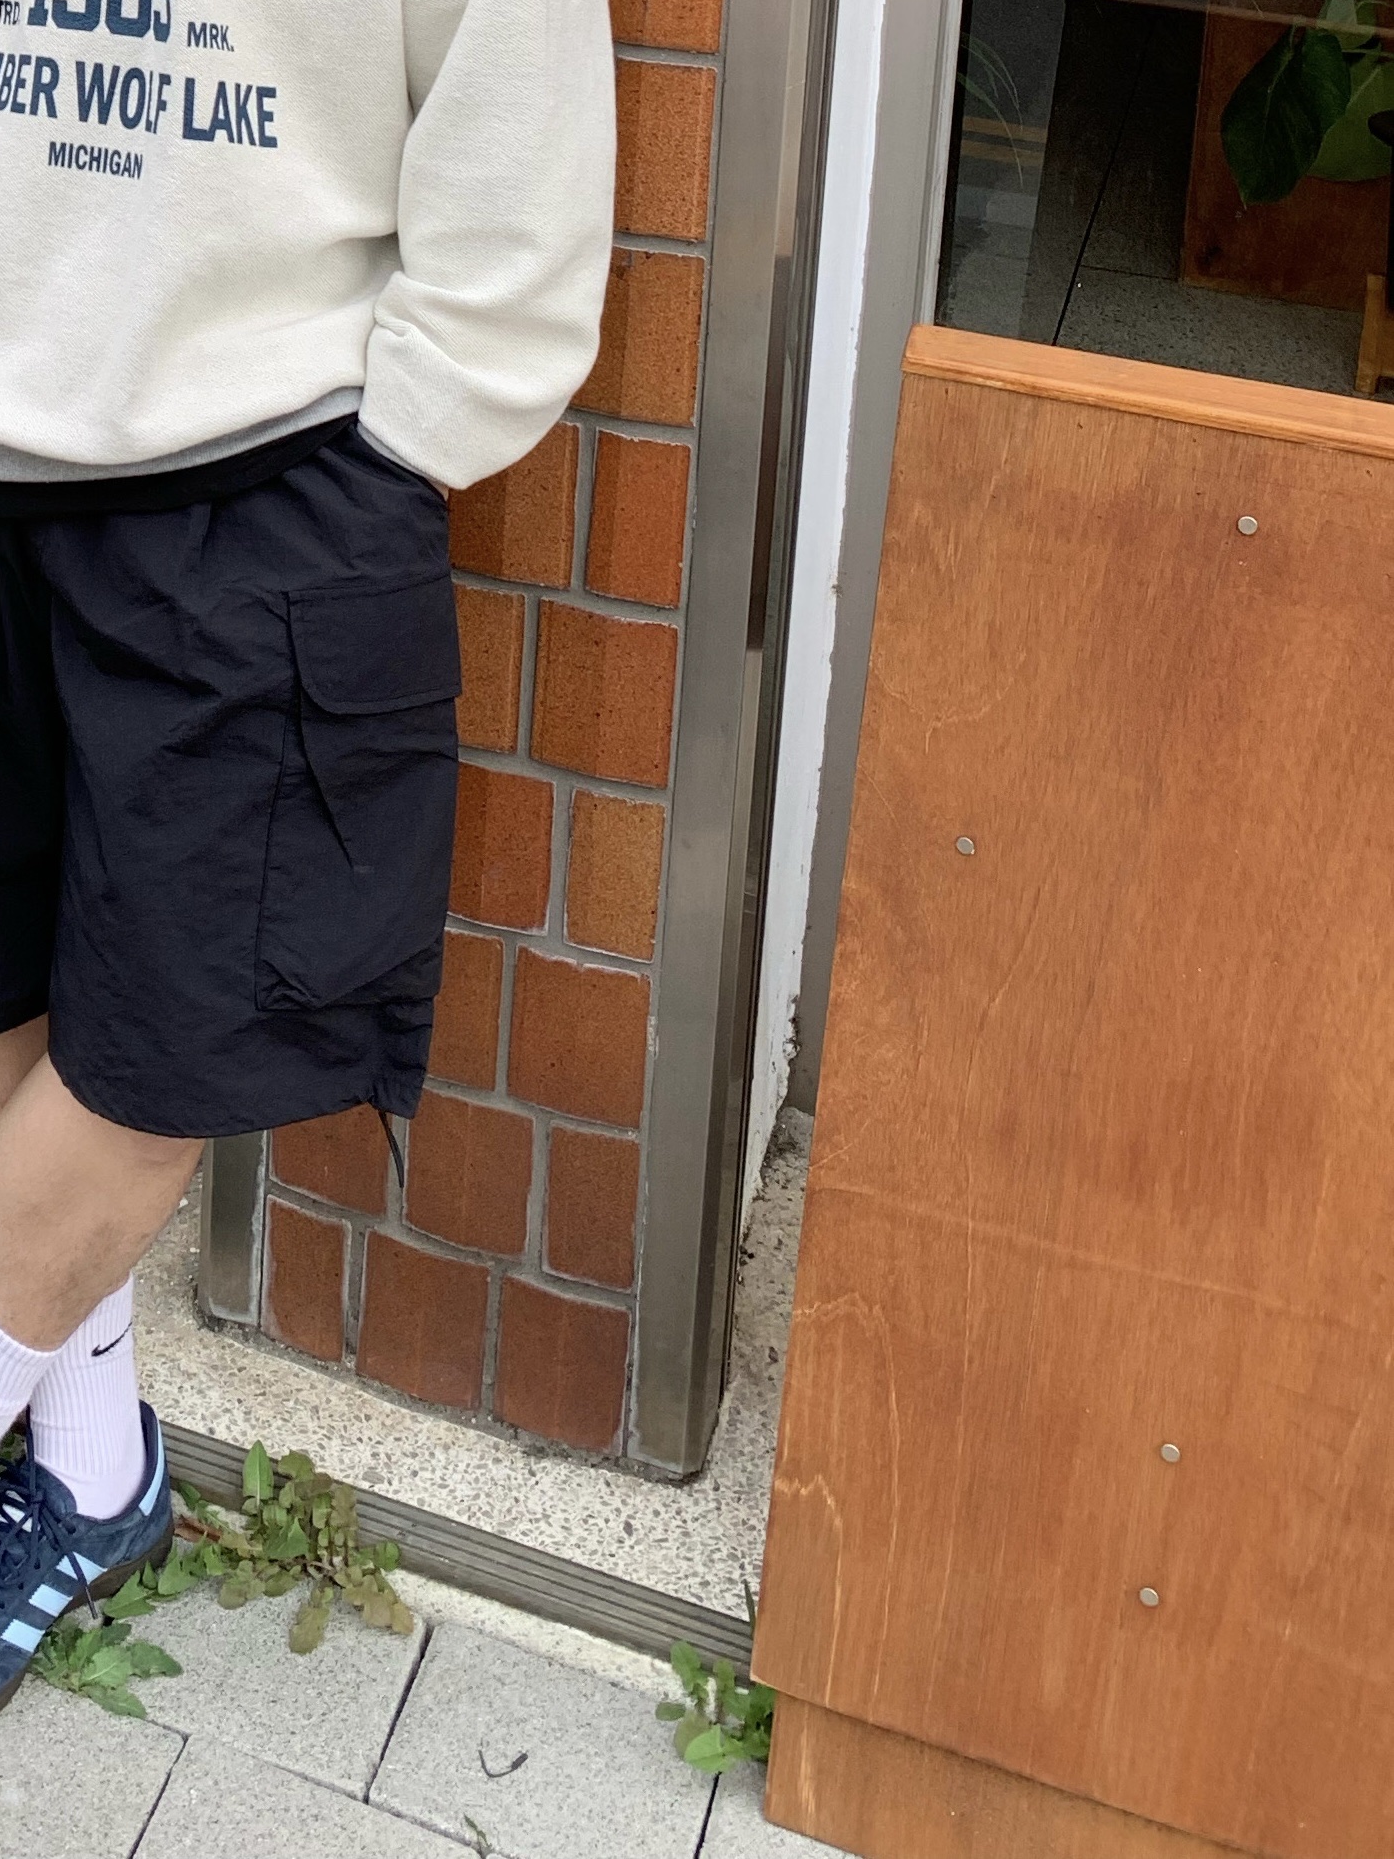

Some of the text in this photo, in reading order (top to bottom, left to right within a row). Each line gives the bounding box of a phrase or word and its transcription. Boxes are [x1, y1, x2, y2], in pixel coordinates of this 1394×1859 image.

[187, 21, 235, 53] MRK.
[75, 60, 172, 135] WOLF
[182, 77, 278, 149] LAKE
[47, 141, 144, 180] MICHIGAN
